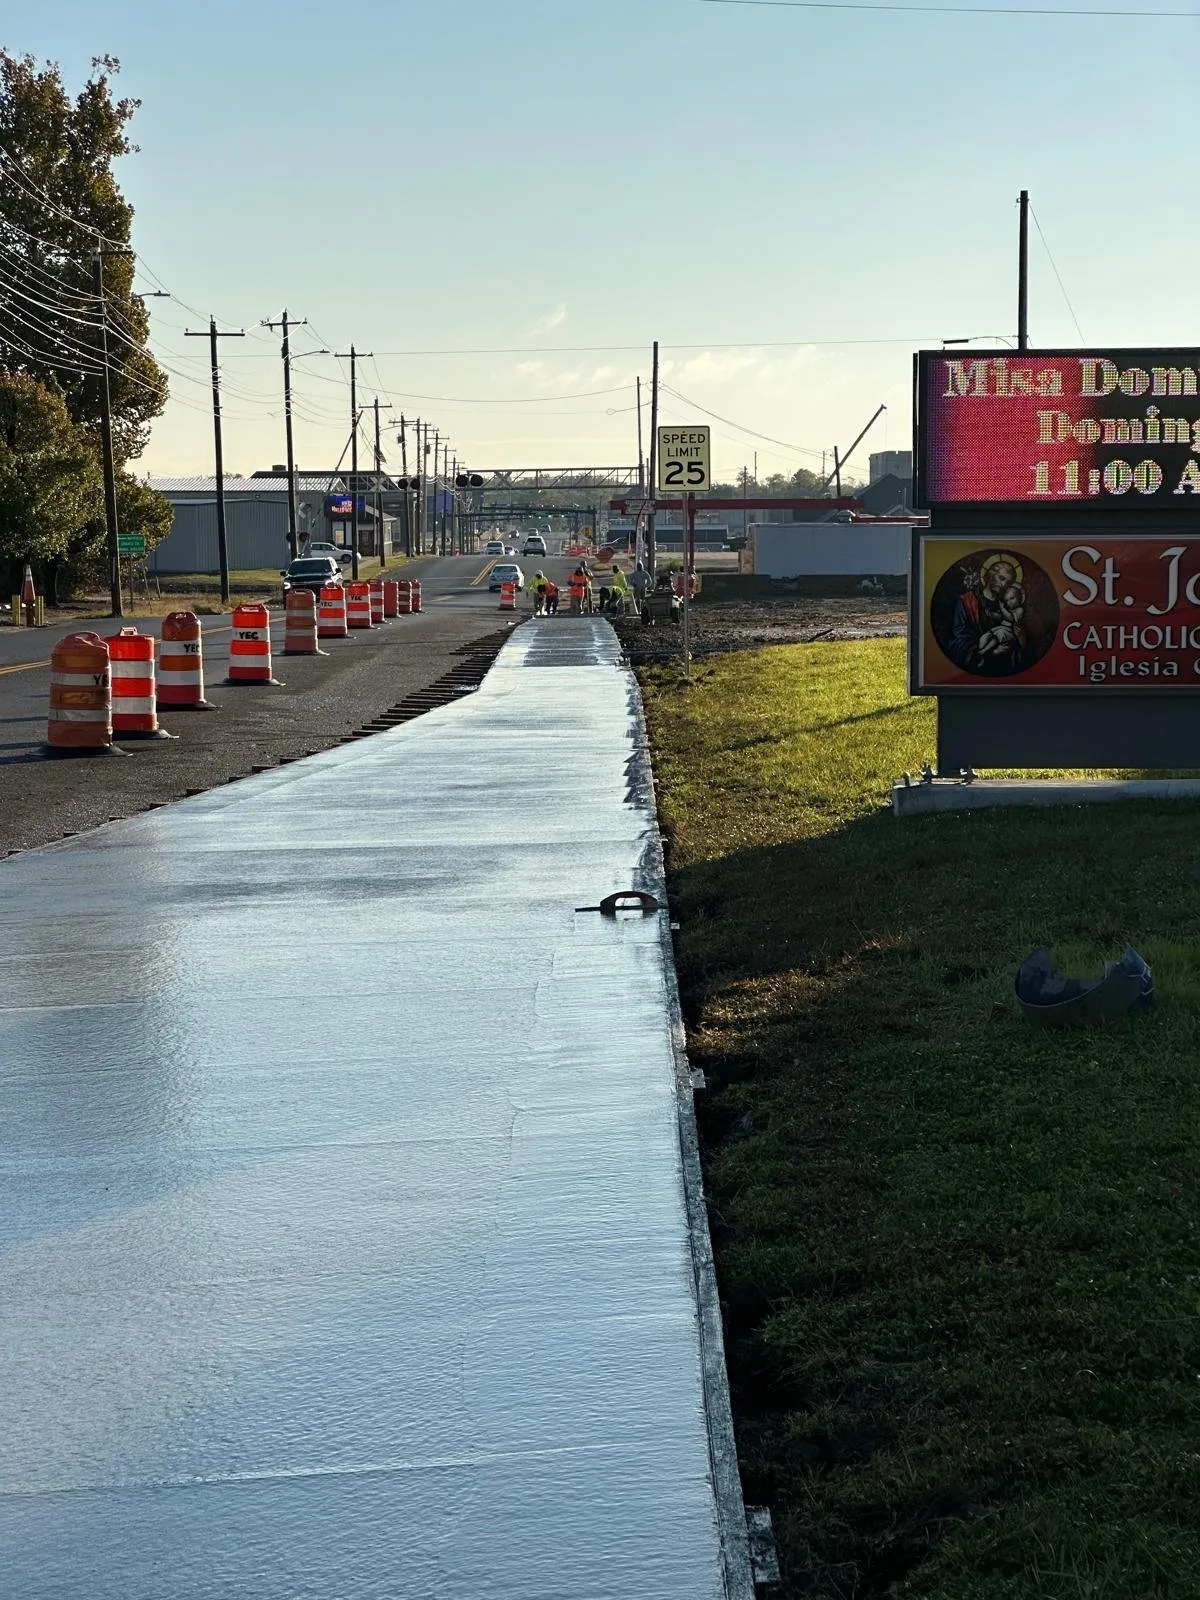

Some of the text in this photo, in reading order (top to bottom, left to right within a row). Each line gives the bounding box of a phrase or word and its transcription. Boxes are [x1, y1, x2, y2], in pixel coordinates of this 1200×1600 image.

[943, 358, 1200, 397] Misa Dom
[663, 433, 706, 444] SPEED
[667, 447, 701, 457] LIMIT
[665, 461, 706, 485] 25
[1027, 460, 1163, 495] 11:00
[1060, 545, 1135, 607] St.
[1079, 655, 1179, 683] Iglesia
